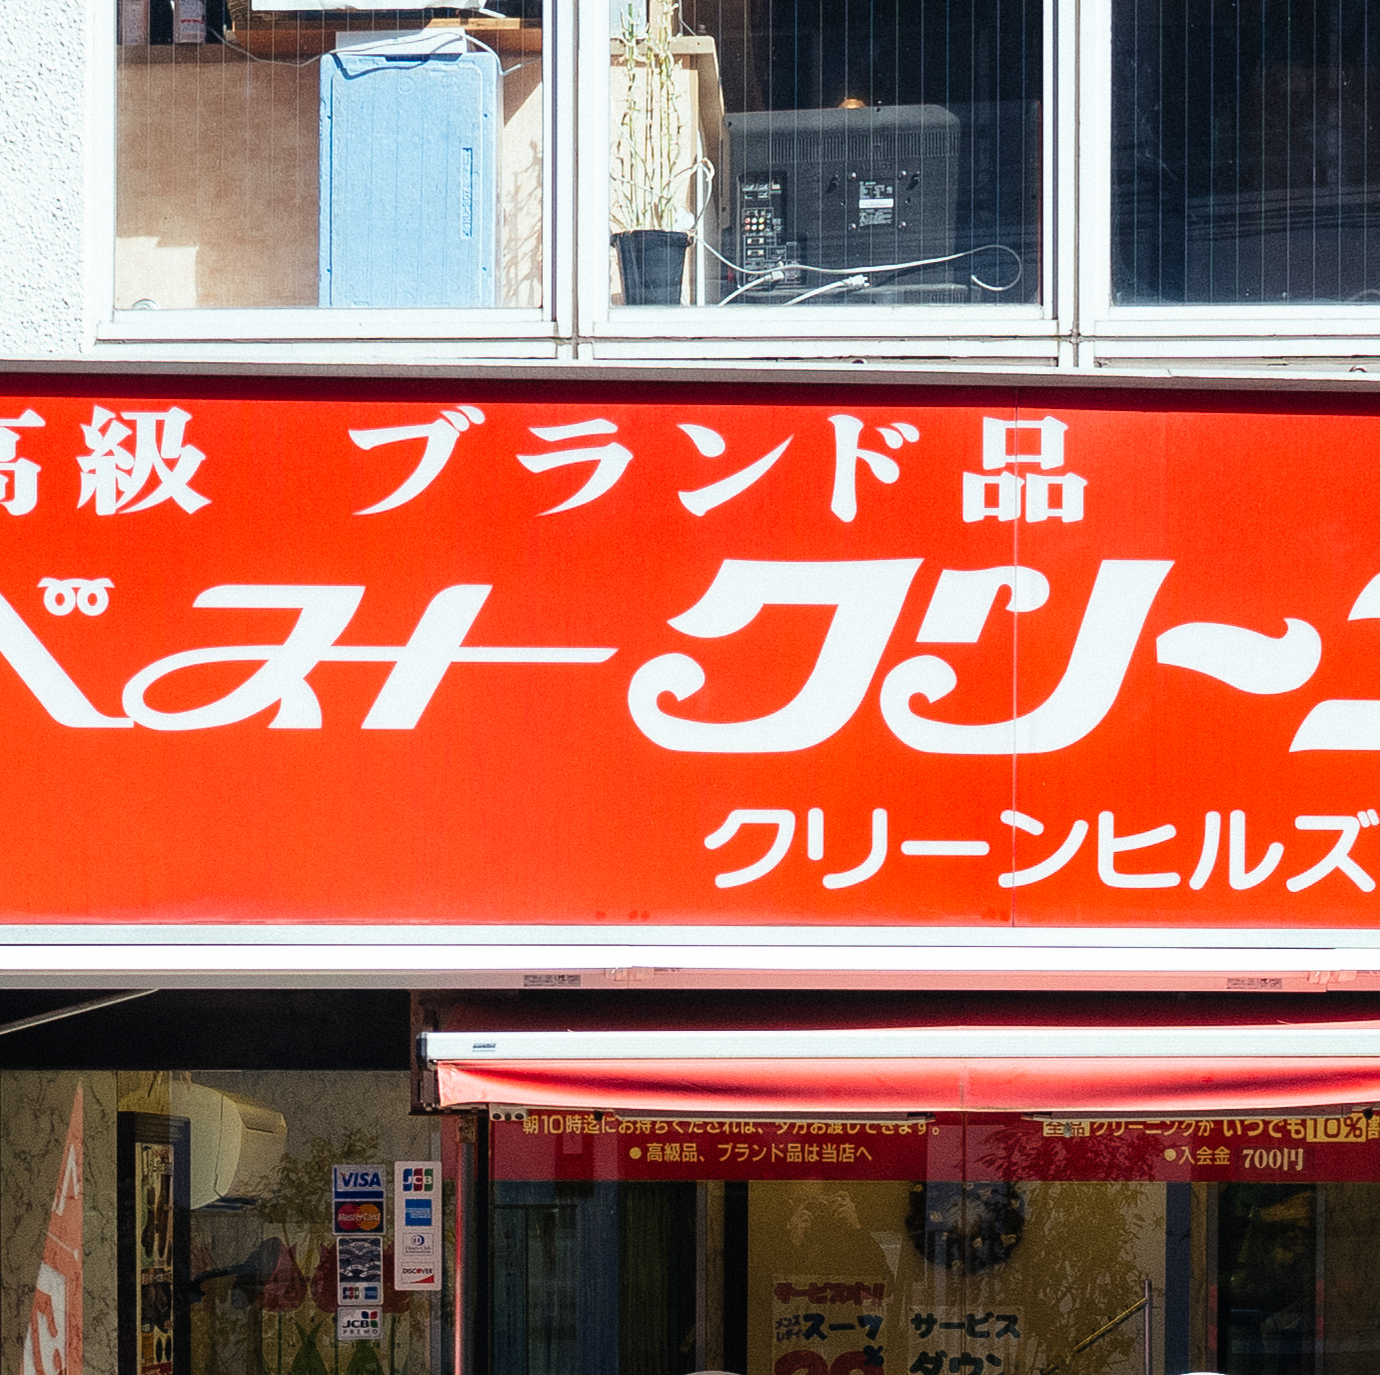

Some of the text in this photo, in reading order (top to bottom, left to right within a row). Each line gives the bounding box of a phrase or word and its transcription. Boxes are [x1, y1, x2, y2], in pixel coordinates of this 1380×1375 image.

[348, 404, 1087, 522] ブランド品
[704, 807, 1380, 892] クリーンヒルズ
[1179, 1146, 1304, 1171] 入会金 700円
[341, 1172, 381, 1188] VISA
[337, 1211, 381, 1222] MasterCard
[402, 1267, 433, 1275] DISCOVER
[341, 1320, 370, 1329] JCB
[910, 1312, 1020, 1339] サービス
